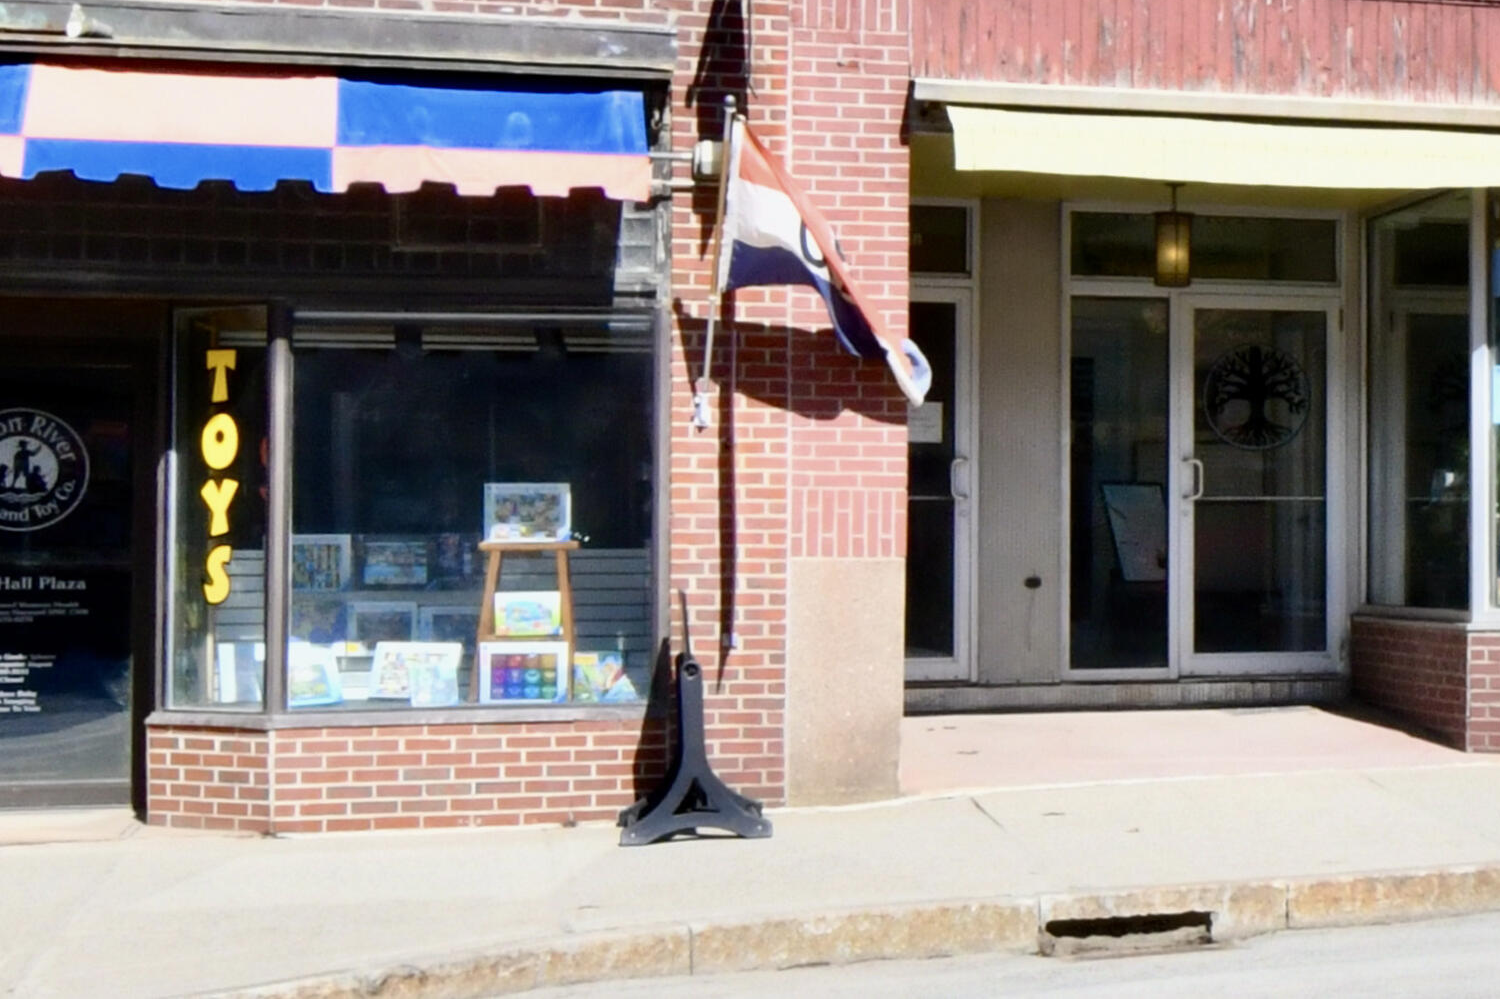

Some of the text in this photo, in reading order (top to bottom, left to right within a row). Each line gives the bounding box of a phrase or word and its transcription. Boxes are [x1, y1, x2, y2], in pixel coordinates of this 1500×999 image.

[30, 415, 76, 462] River
[200, 349, 239, 605] TOYS
[30, 499, 60, 519] Toy
[54, 479, 77, 501] Co.
[38, 576, 87, 590] Plaza
